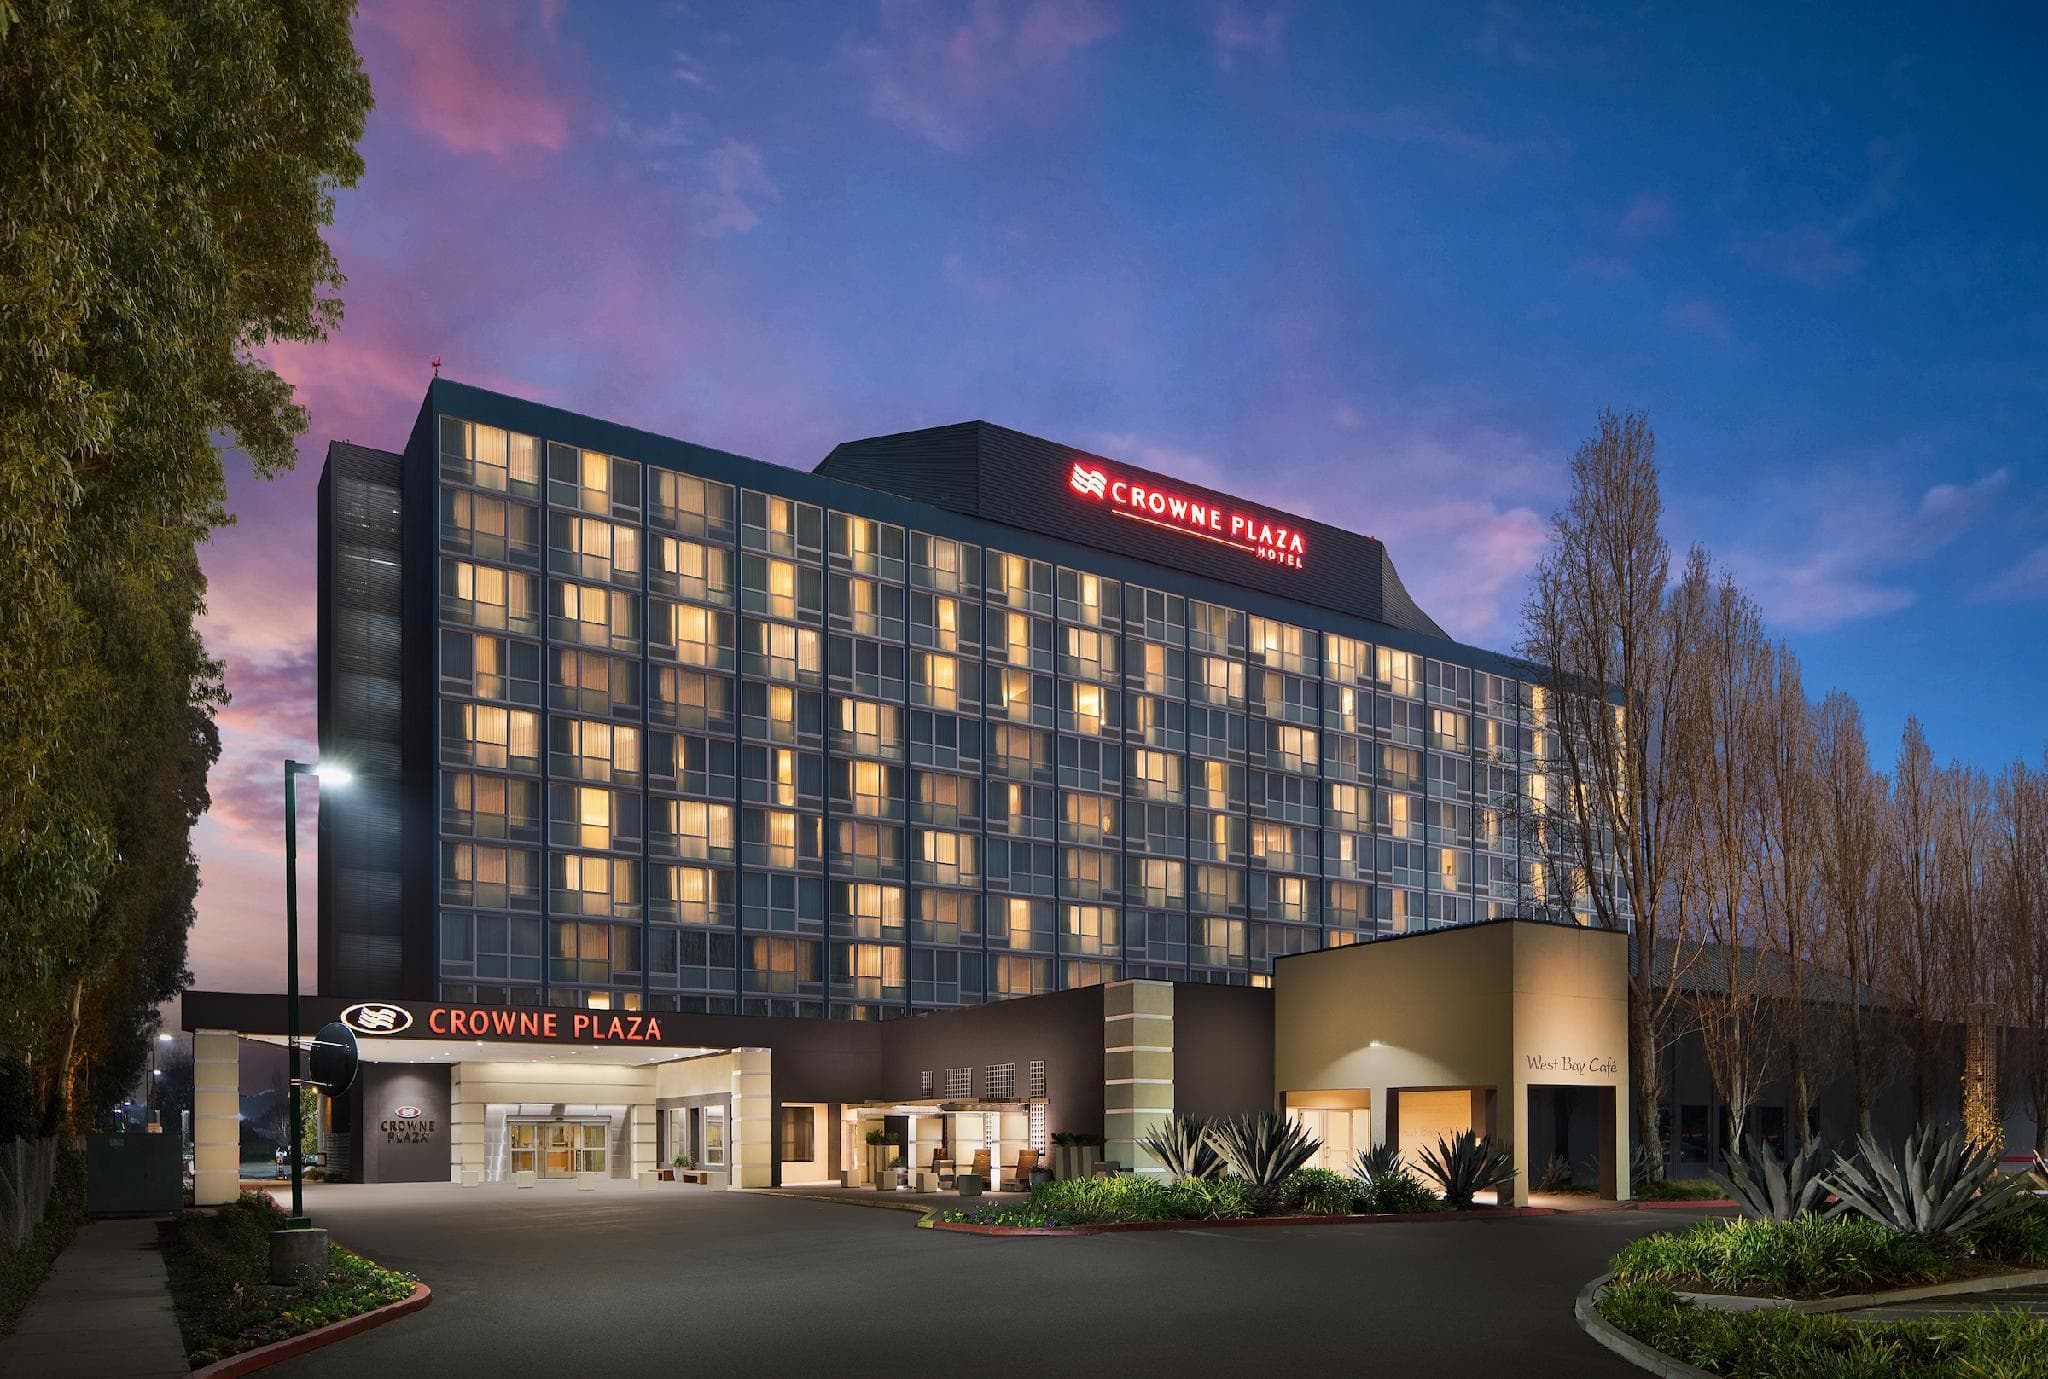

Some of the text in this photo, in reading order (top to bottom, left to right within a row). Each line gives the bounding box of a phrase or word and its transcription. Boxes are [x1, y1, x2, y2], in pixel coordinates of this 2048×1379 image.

[1110, 481, 1304, 555] CROWNE PLAZA
[1256, 546, 1303, 570] HOTEL
[428, 1007, 662, 1041] CROWNE PLAZA
[1526, 1055, 1618, 1078] West Bay Café
[380, 1120, 435, 1132] CROWNE
[387, 1131, 430, 1144] PLAZA
